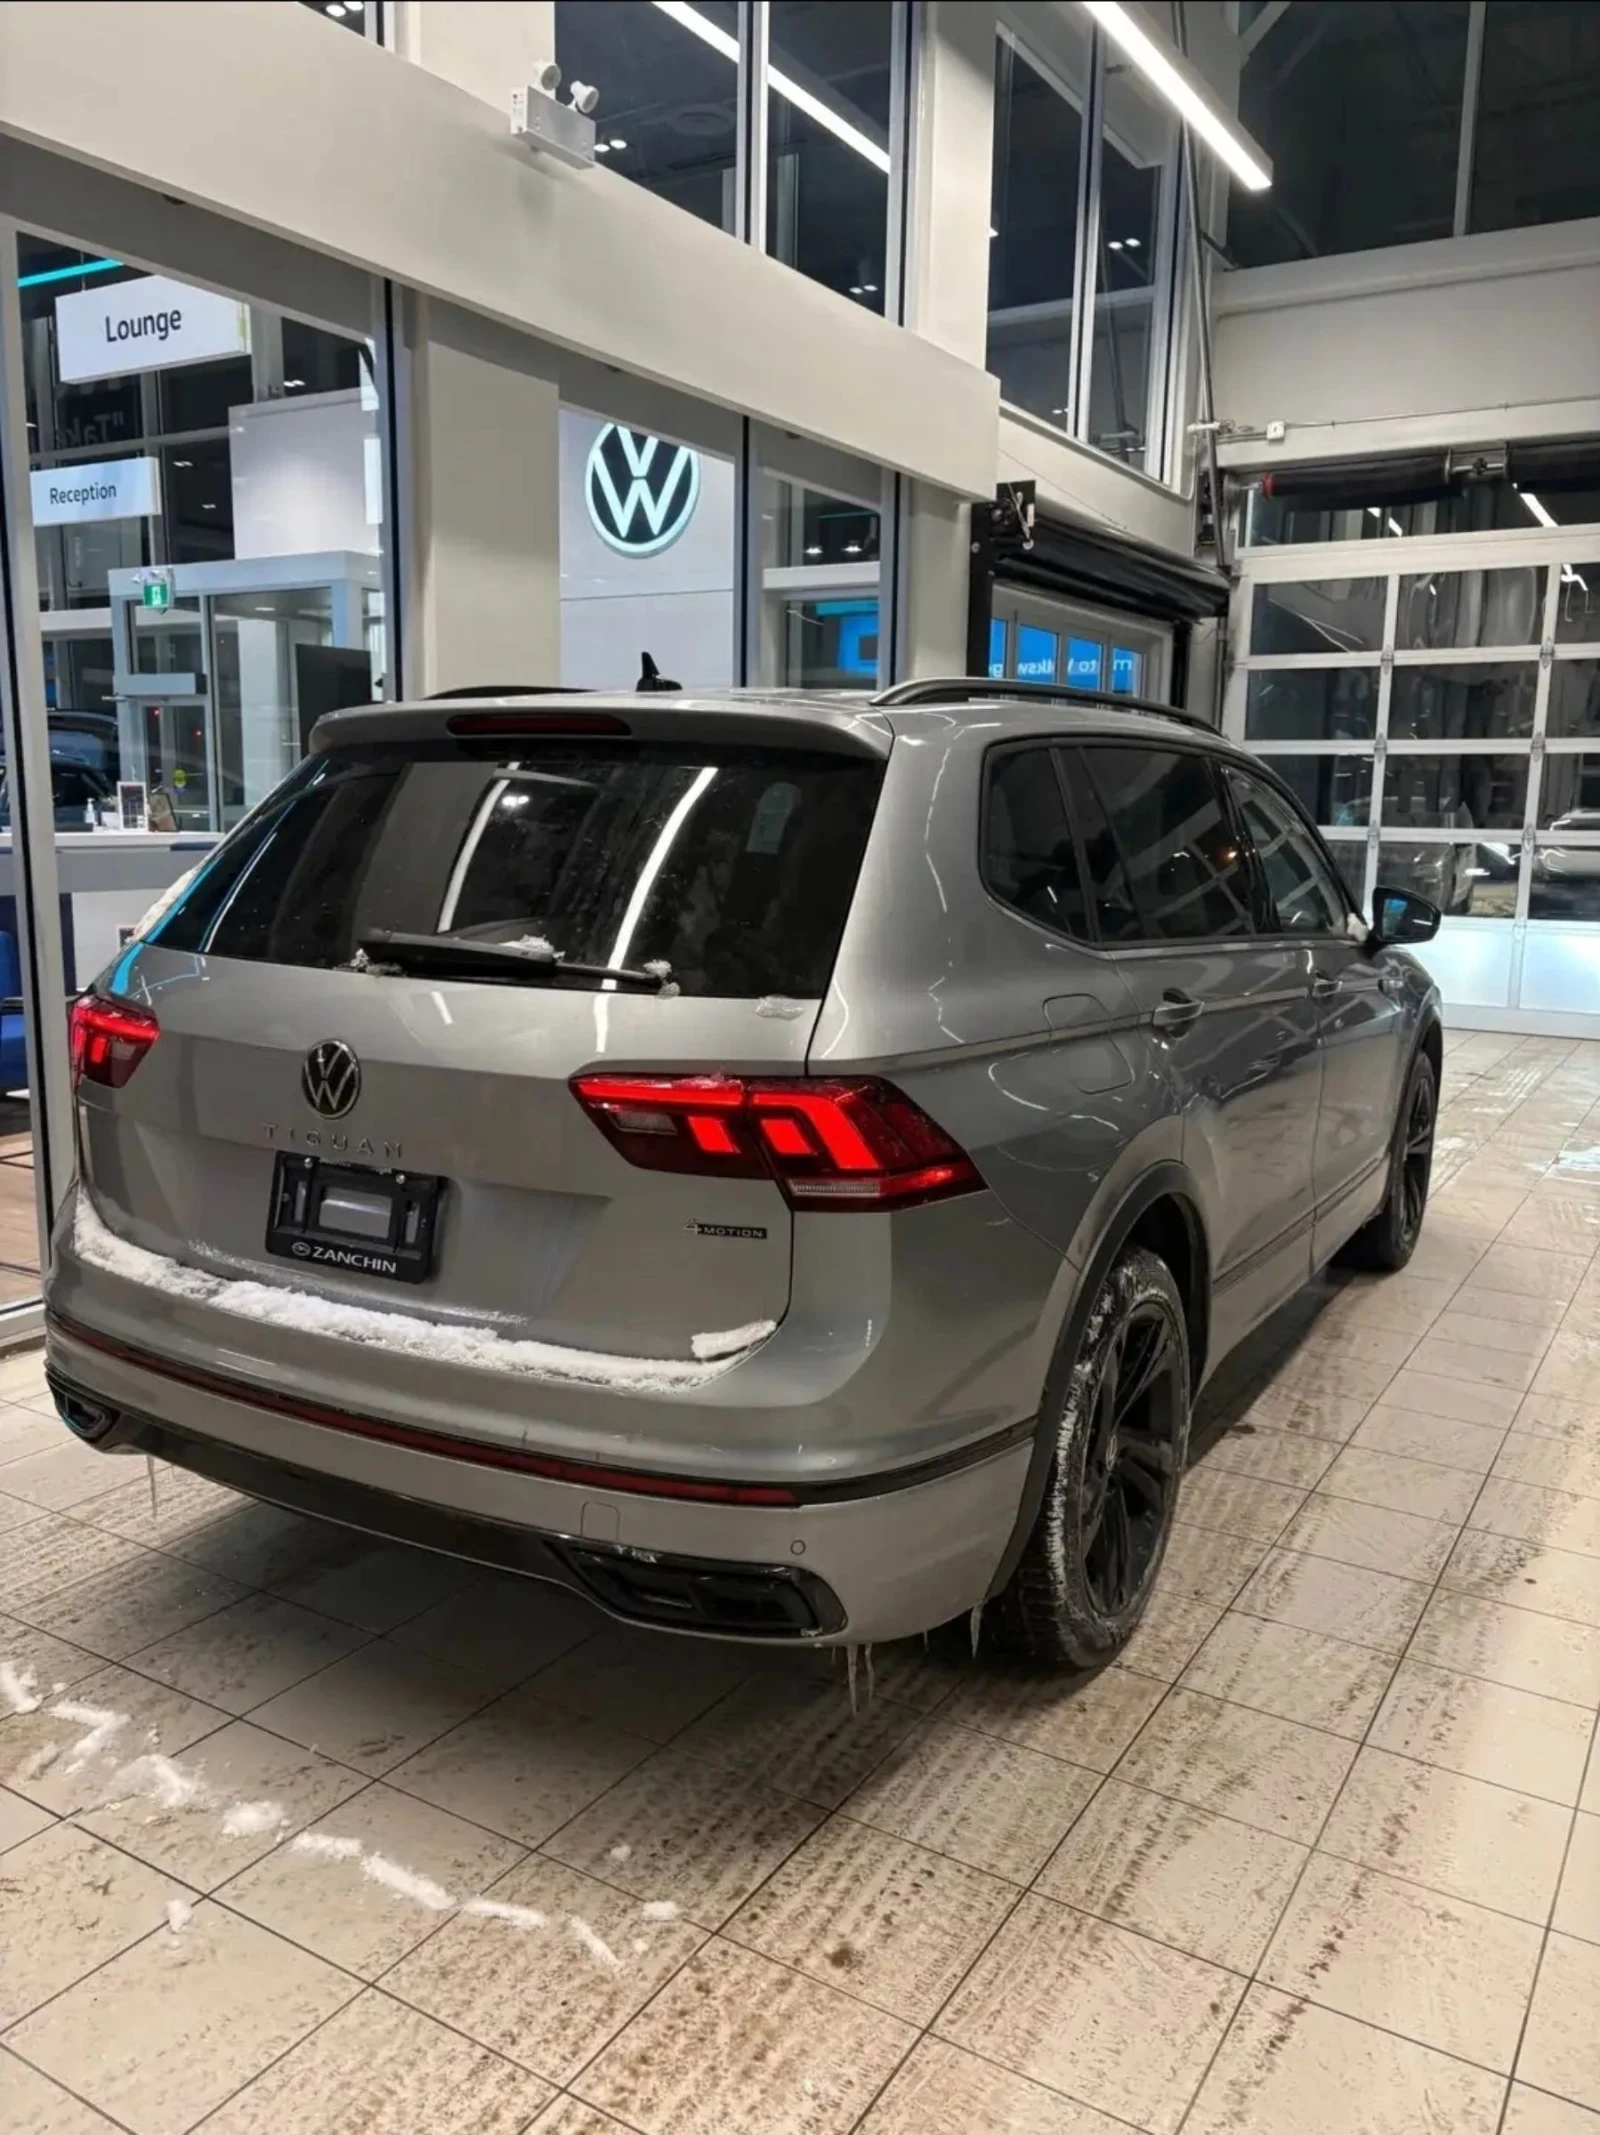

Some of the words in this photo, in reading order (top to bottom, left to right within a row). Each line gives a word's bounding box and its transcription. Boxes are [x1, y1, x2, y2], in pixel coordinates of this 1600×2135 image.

[105, 309, 182, 342] Lounge
[49, 482, 117, 505] Reception
[591, 423, 693, 538] VW
[304, 1044, 357, 1112] VW
[261, 1122, 403, 1158] TIGUAN
[682, 1219, 764, 1239] 4MOTION
[312, 1246, 397, 1274] ZANCHIN
